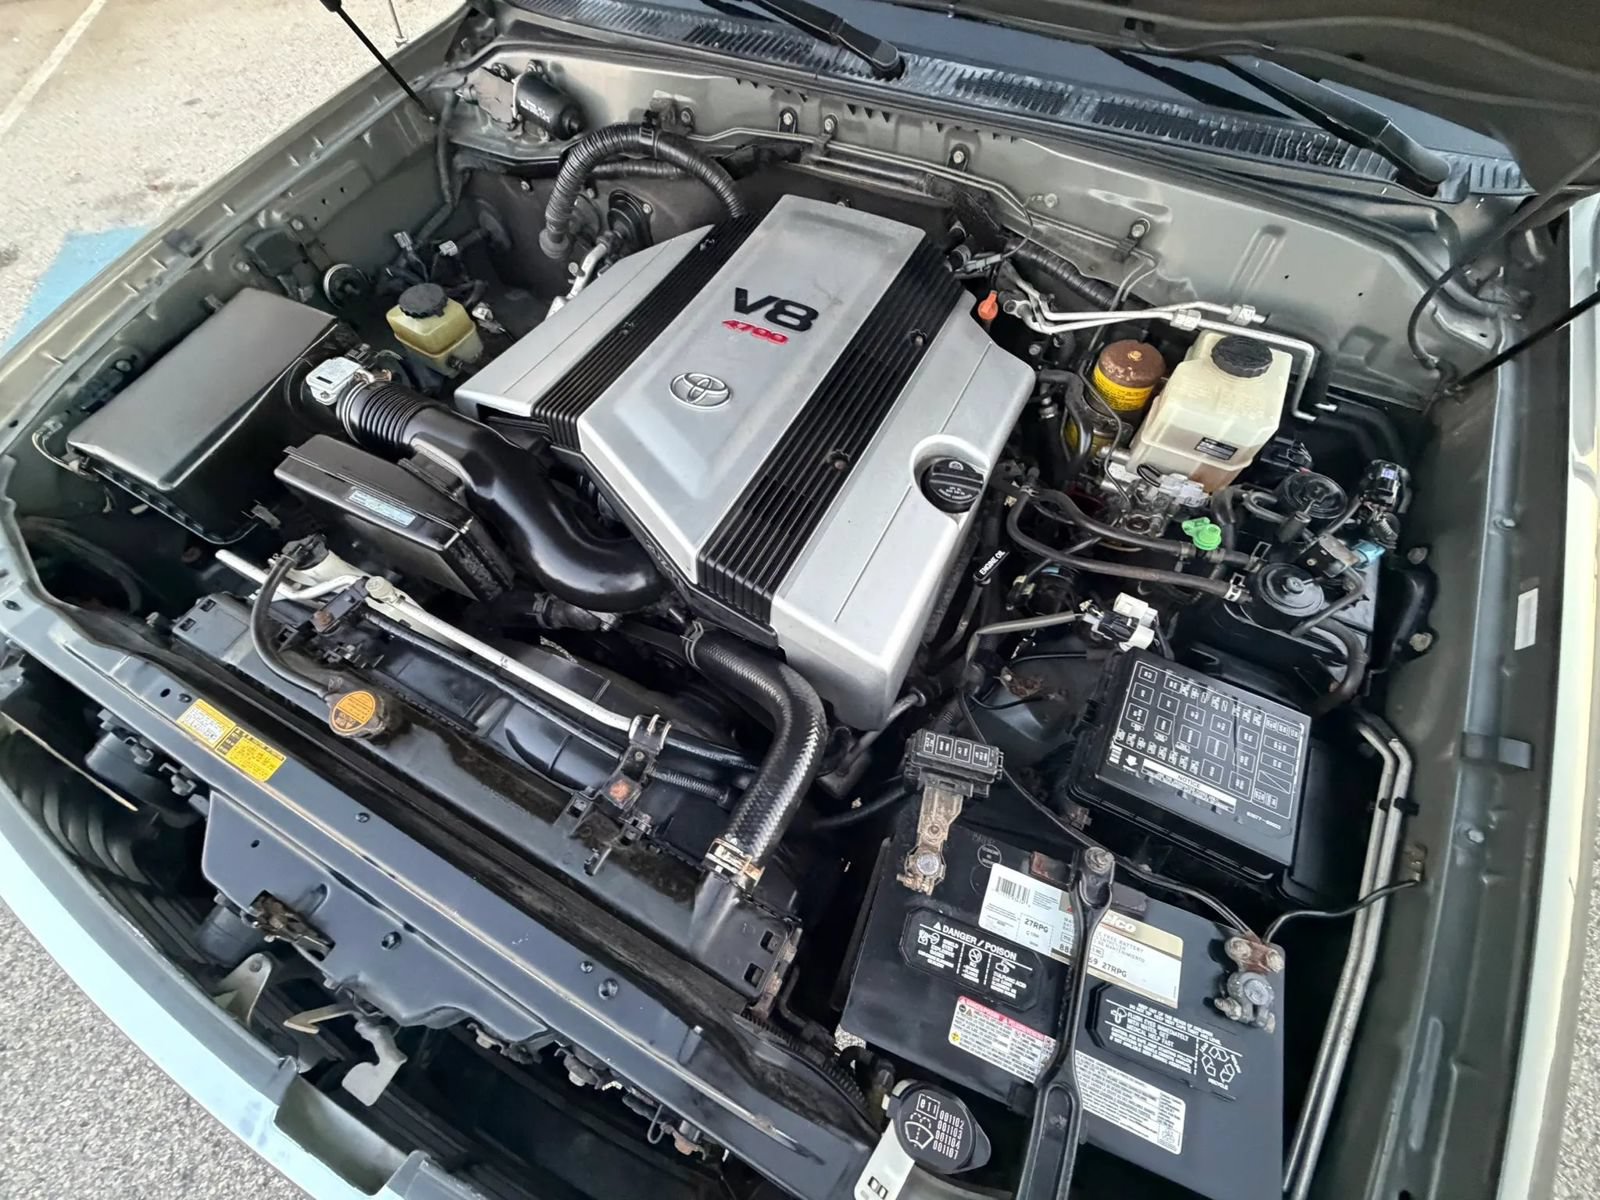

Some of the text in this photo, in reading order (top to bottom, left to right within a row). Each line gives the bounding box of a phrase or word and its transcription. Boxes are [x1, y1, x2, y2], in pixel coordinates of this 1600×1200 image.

[734, 287, 819, 332] V8
[721, 319, 789, 346] 4700
[1024, 918, 1049, 933] 27RPG
[942, 924, 978, 944] DANGER
[983, 941, 1017, 961] POISON
[1102, 961, 1127, 978] 27RPG
[937, 1120, 962, 1140] 001103
[939, 1110, 964, 1130] 001102
[933, 1140, 959, 1160] 001107
[935, 1130, 960, 1150] 001104
